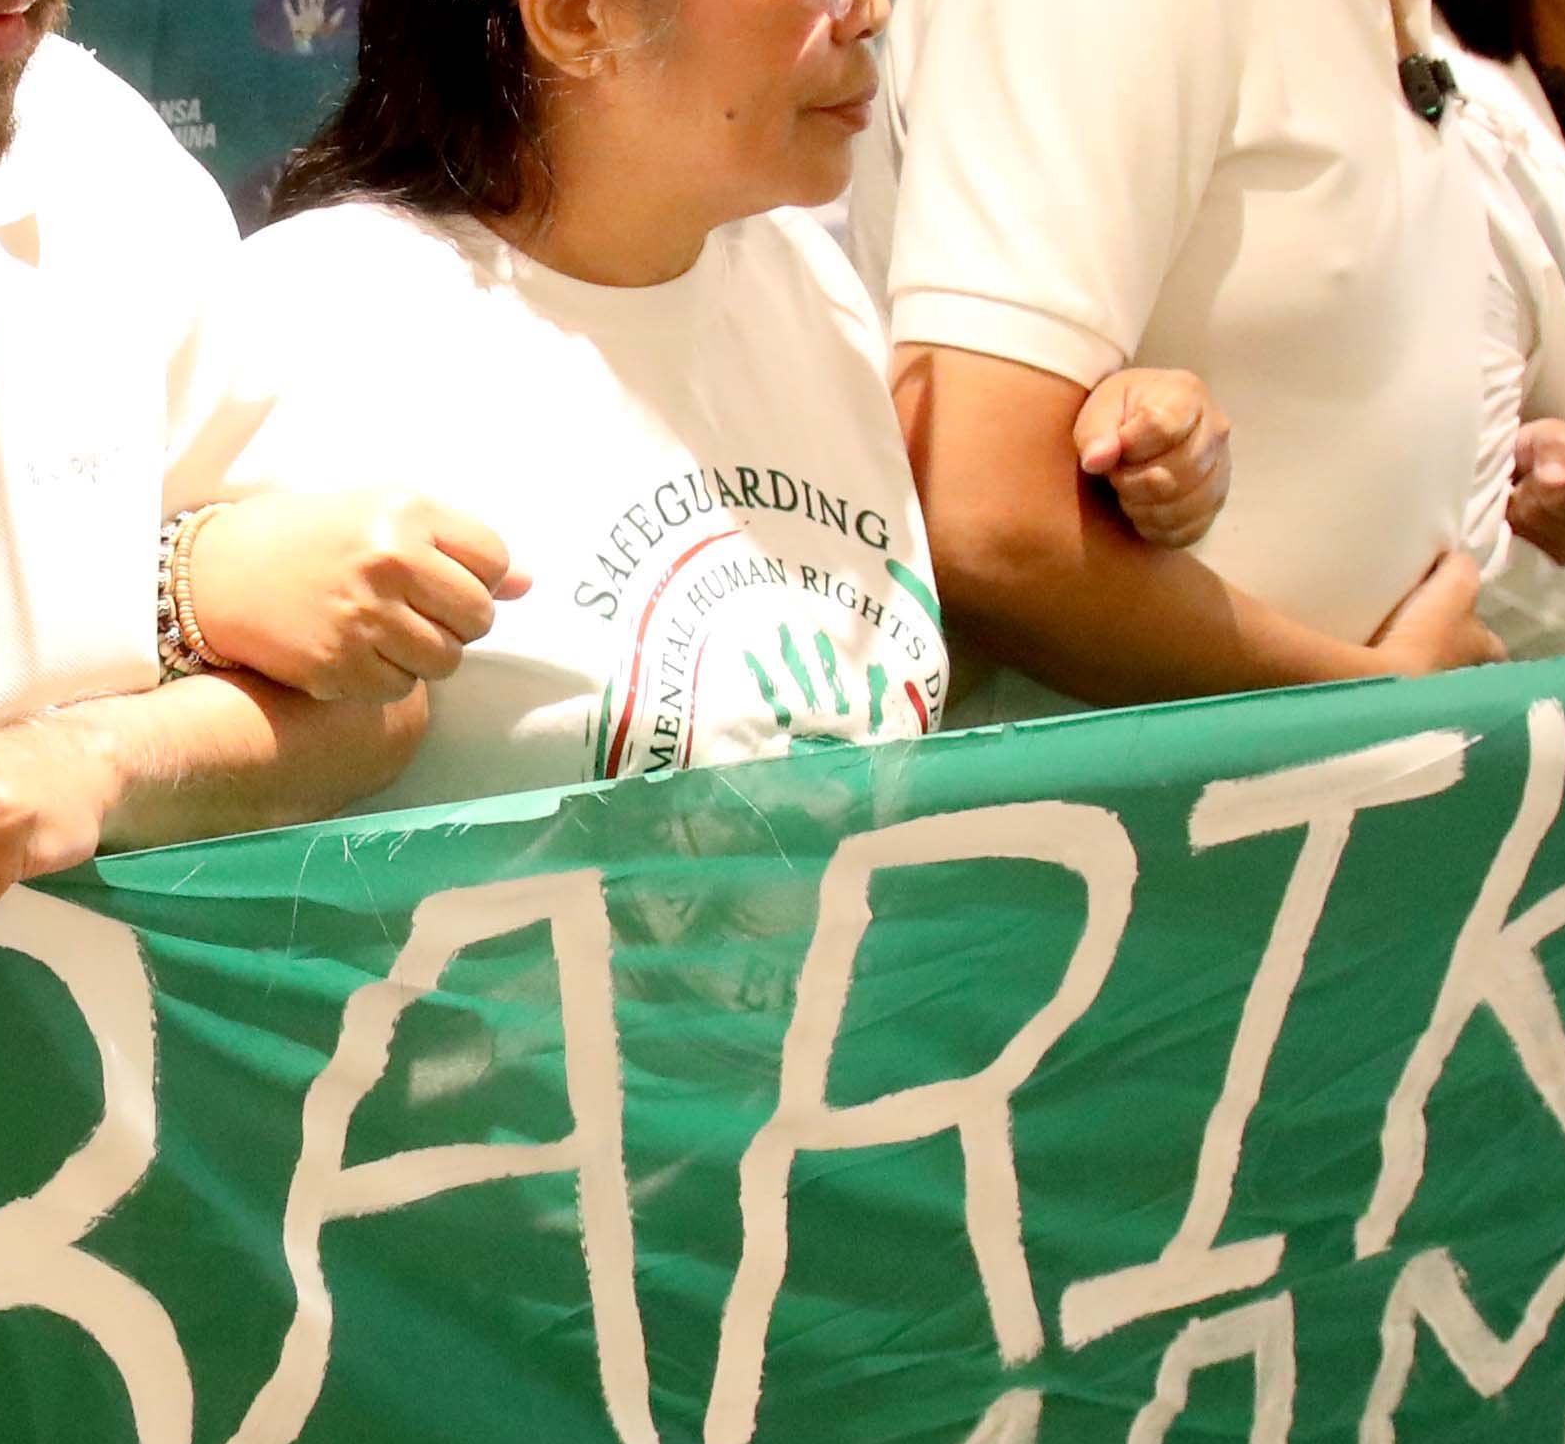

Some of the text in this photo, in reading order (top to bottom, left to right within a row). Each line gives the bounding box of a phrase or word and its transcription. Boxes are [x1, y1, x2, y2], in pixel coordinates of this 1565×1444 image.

[575, 466, 891, 622] SAFEGUARDING
[687, 557, 787, 616] HUMAN
[802, 565, 926, 662] RIGHTS
